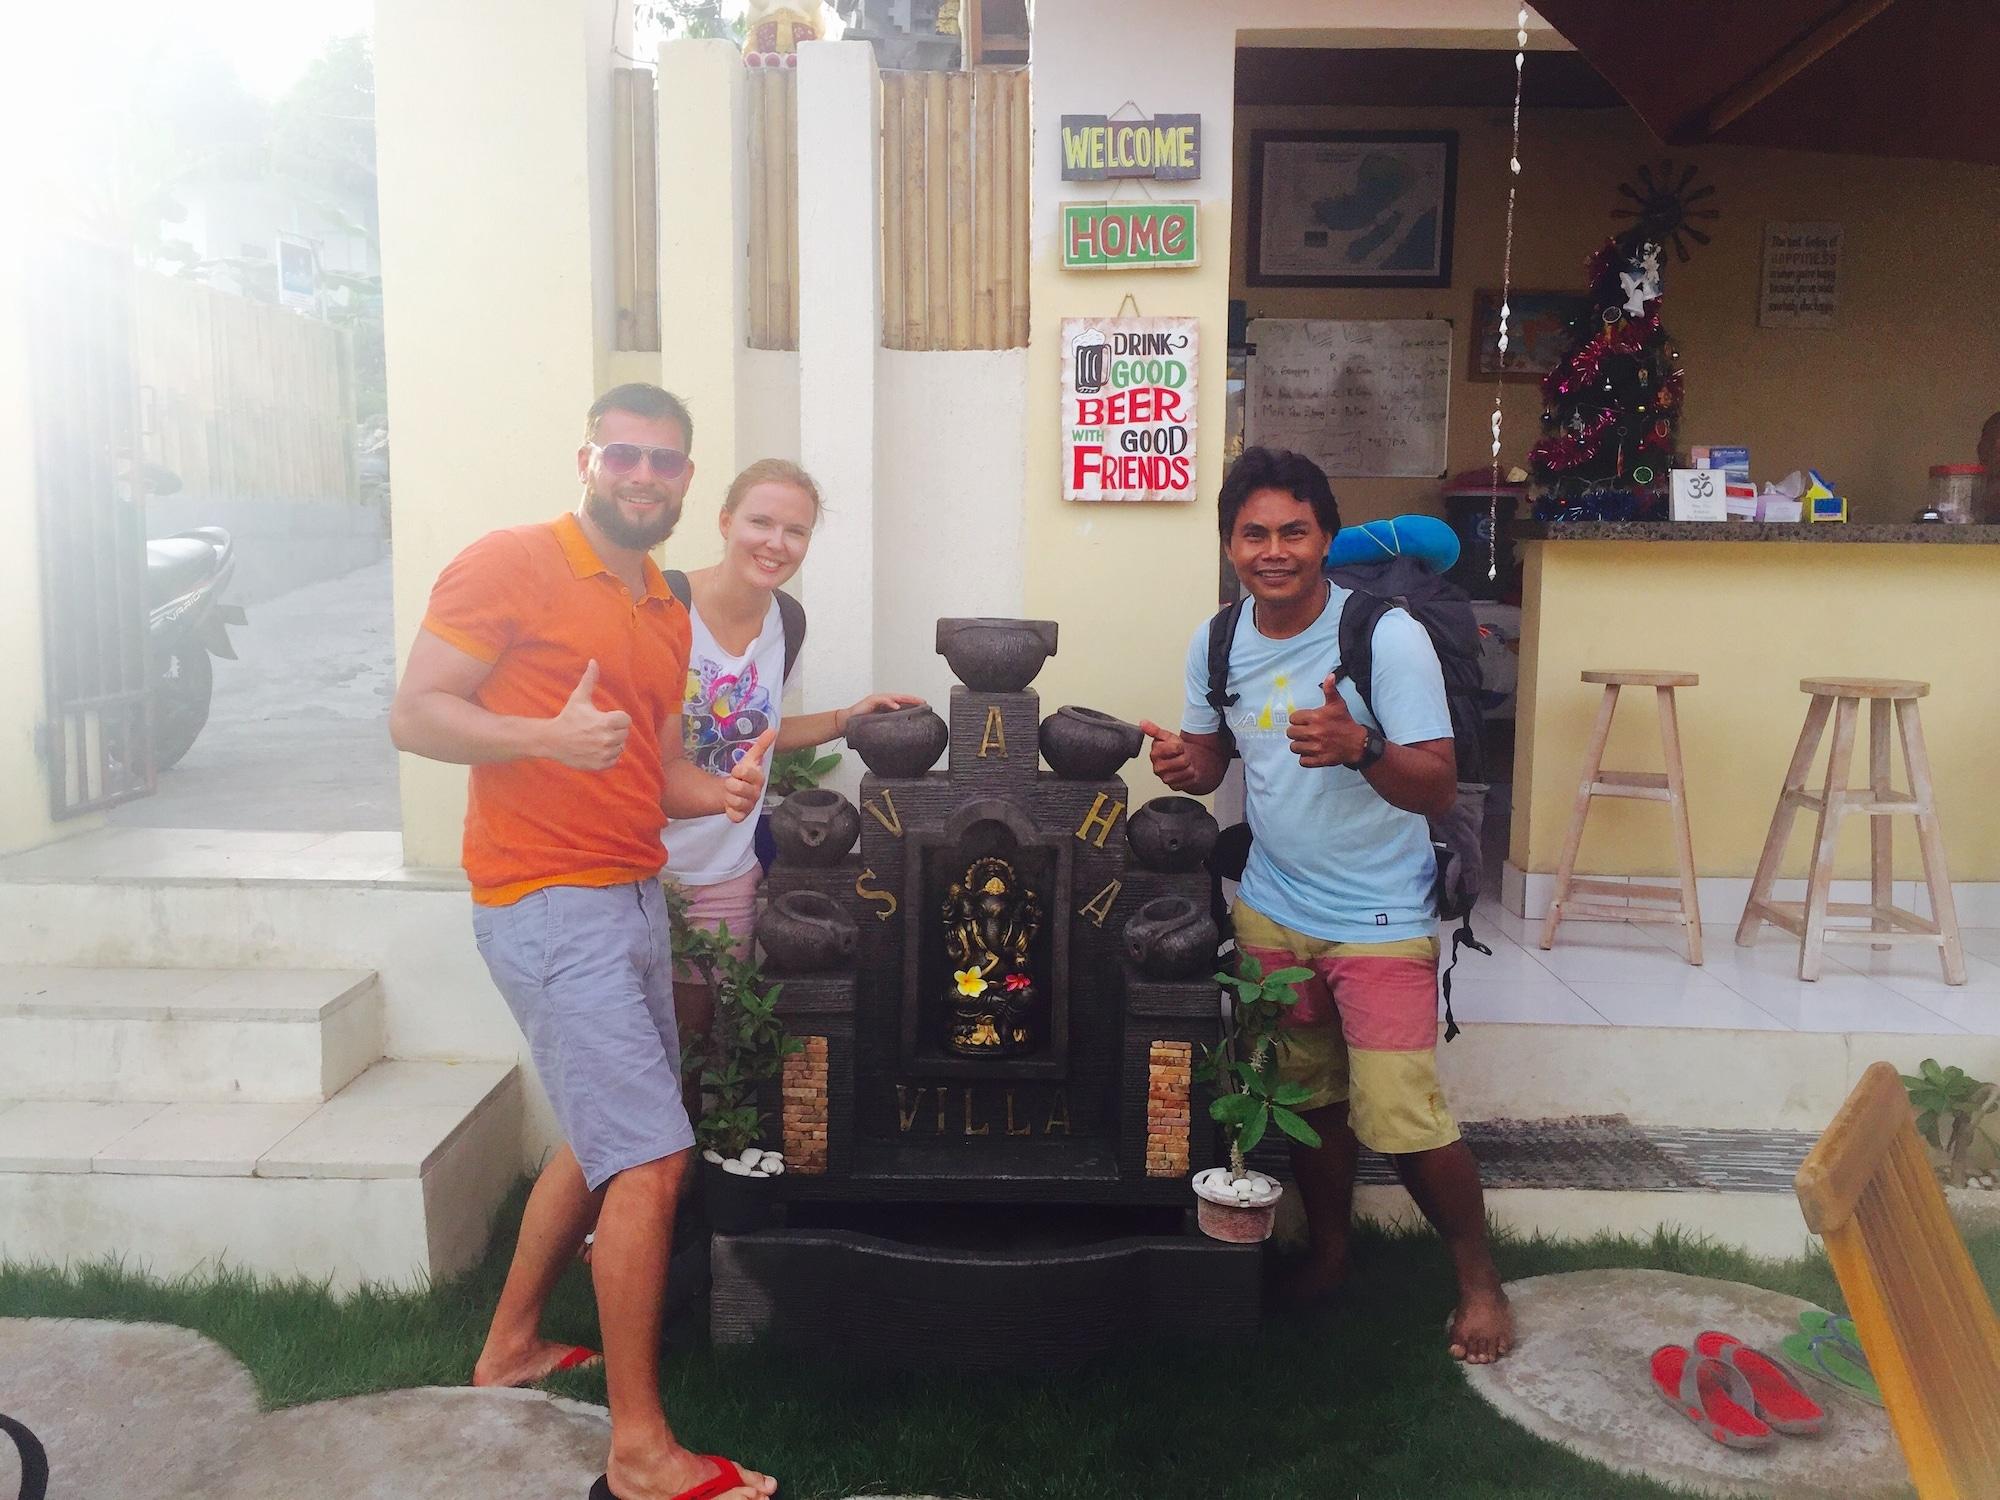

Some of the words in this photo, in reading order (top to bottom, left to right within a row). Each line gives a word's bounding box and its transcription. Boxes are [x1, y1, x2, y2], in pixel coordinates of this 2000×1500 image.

[1062, 126, 1195, 169] WELCOME
[1113, 332, 1188, 356] DRINK
[1111, 359, 1187, 389] GOOD
[1075, 387, 1187, 426] BEER
[1072, 429, 1105, 442] WITH
[1120, 425, 1188, 456] GOOD
[1072, 445, 1190, 490] FRIENDS
[896, 1084, 1072, 1136] VILLA
